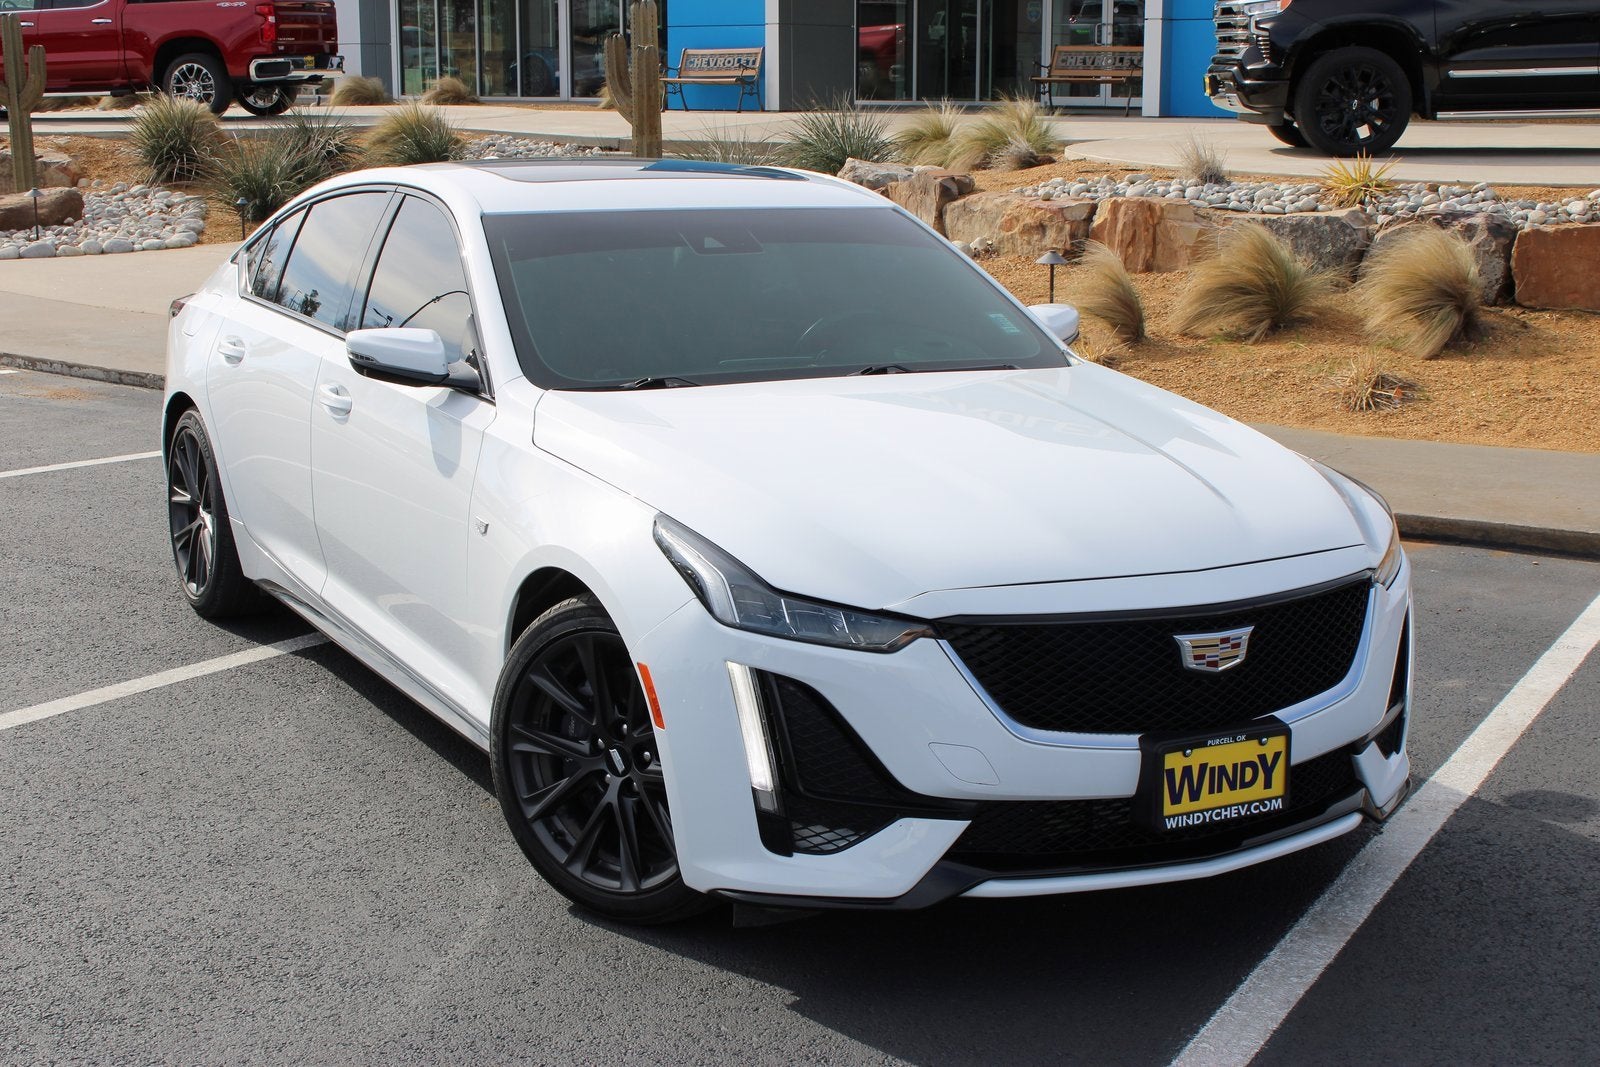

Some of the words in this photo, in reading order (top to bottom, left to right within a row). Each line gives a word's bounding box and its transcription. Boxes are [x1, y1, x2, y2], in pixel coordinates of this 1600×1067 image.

[687, 56, 757, 68] CHEVROLET
[1236, 734, 1247, 742] OK
[1165, 751, 1282, 805] WINDY
[1165, 798, 1283, 829] WINDYCHEV.COM
